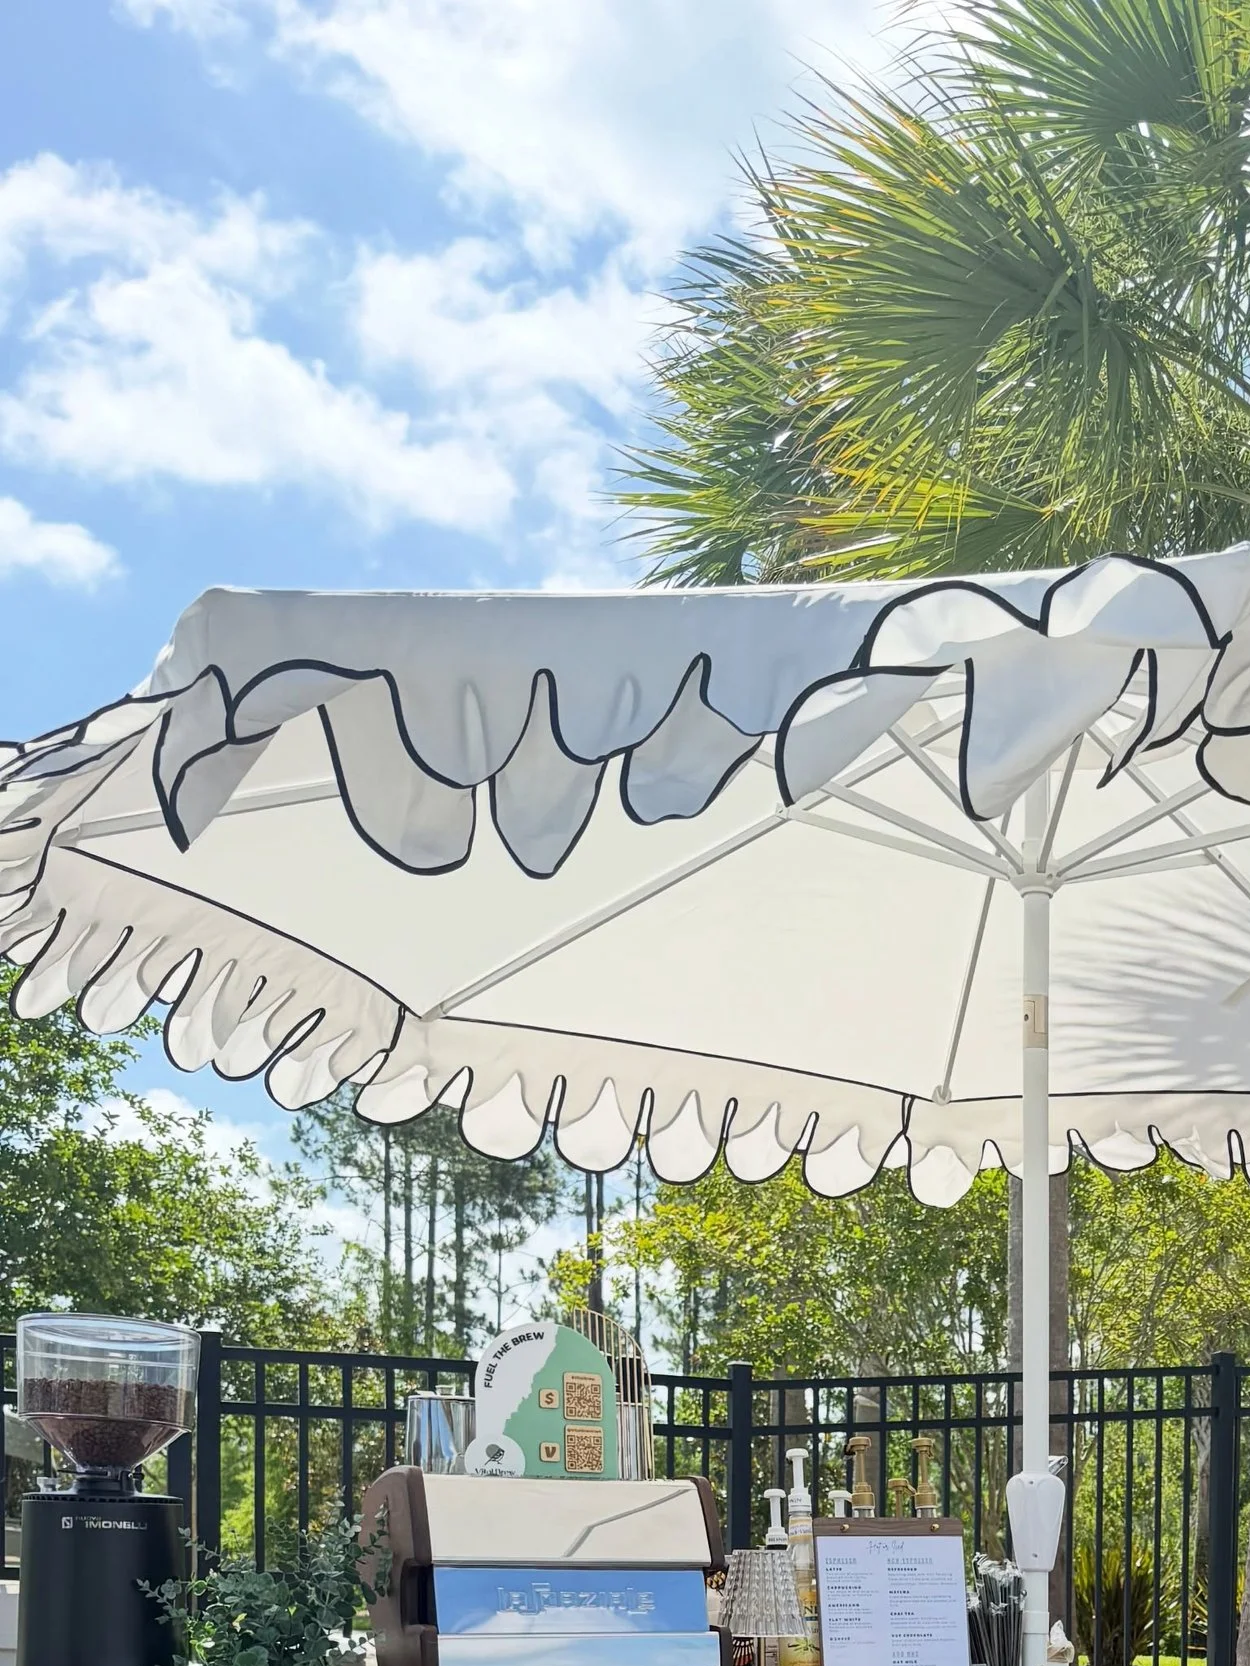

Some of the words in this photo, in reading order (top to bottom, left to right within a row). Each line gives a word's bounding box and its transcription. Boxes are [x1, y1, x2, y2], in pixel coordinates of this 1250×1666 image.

[484, 1362, 498, 1389] FUEL
[492, 1342, 512, 1361] THE
[511, 1331, 545, 1346] BREW
